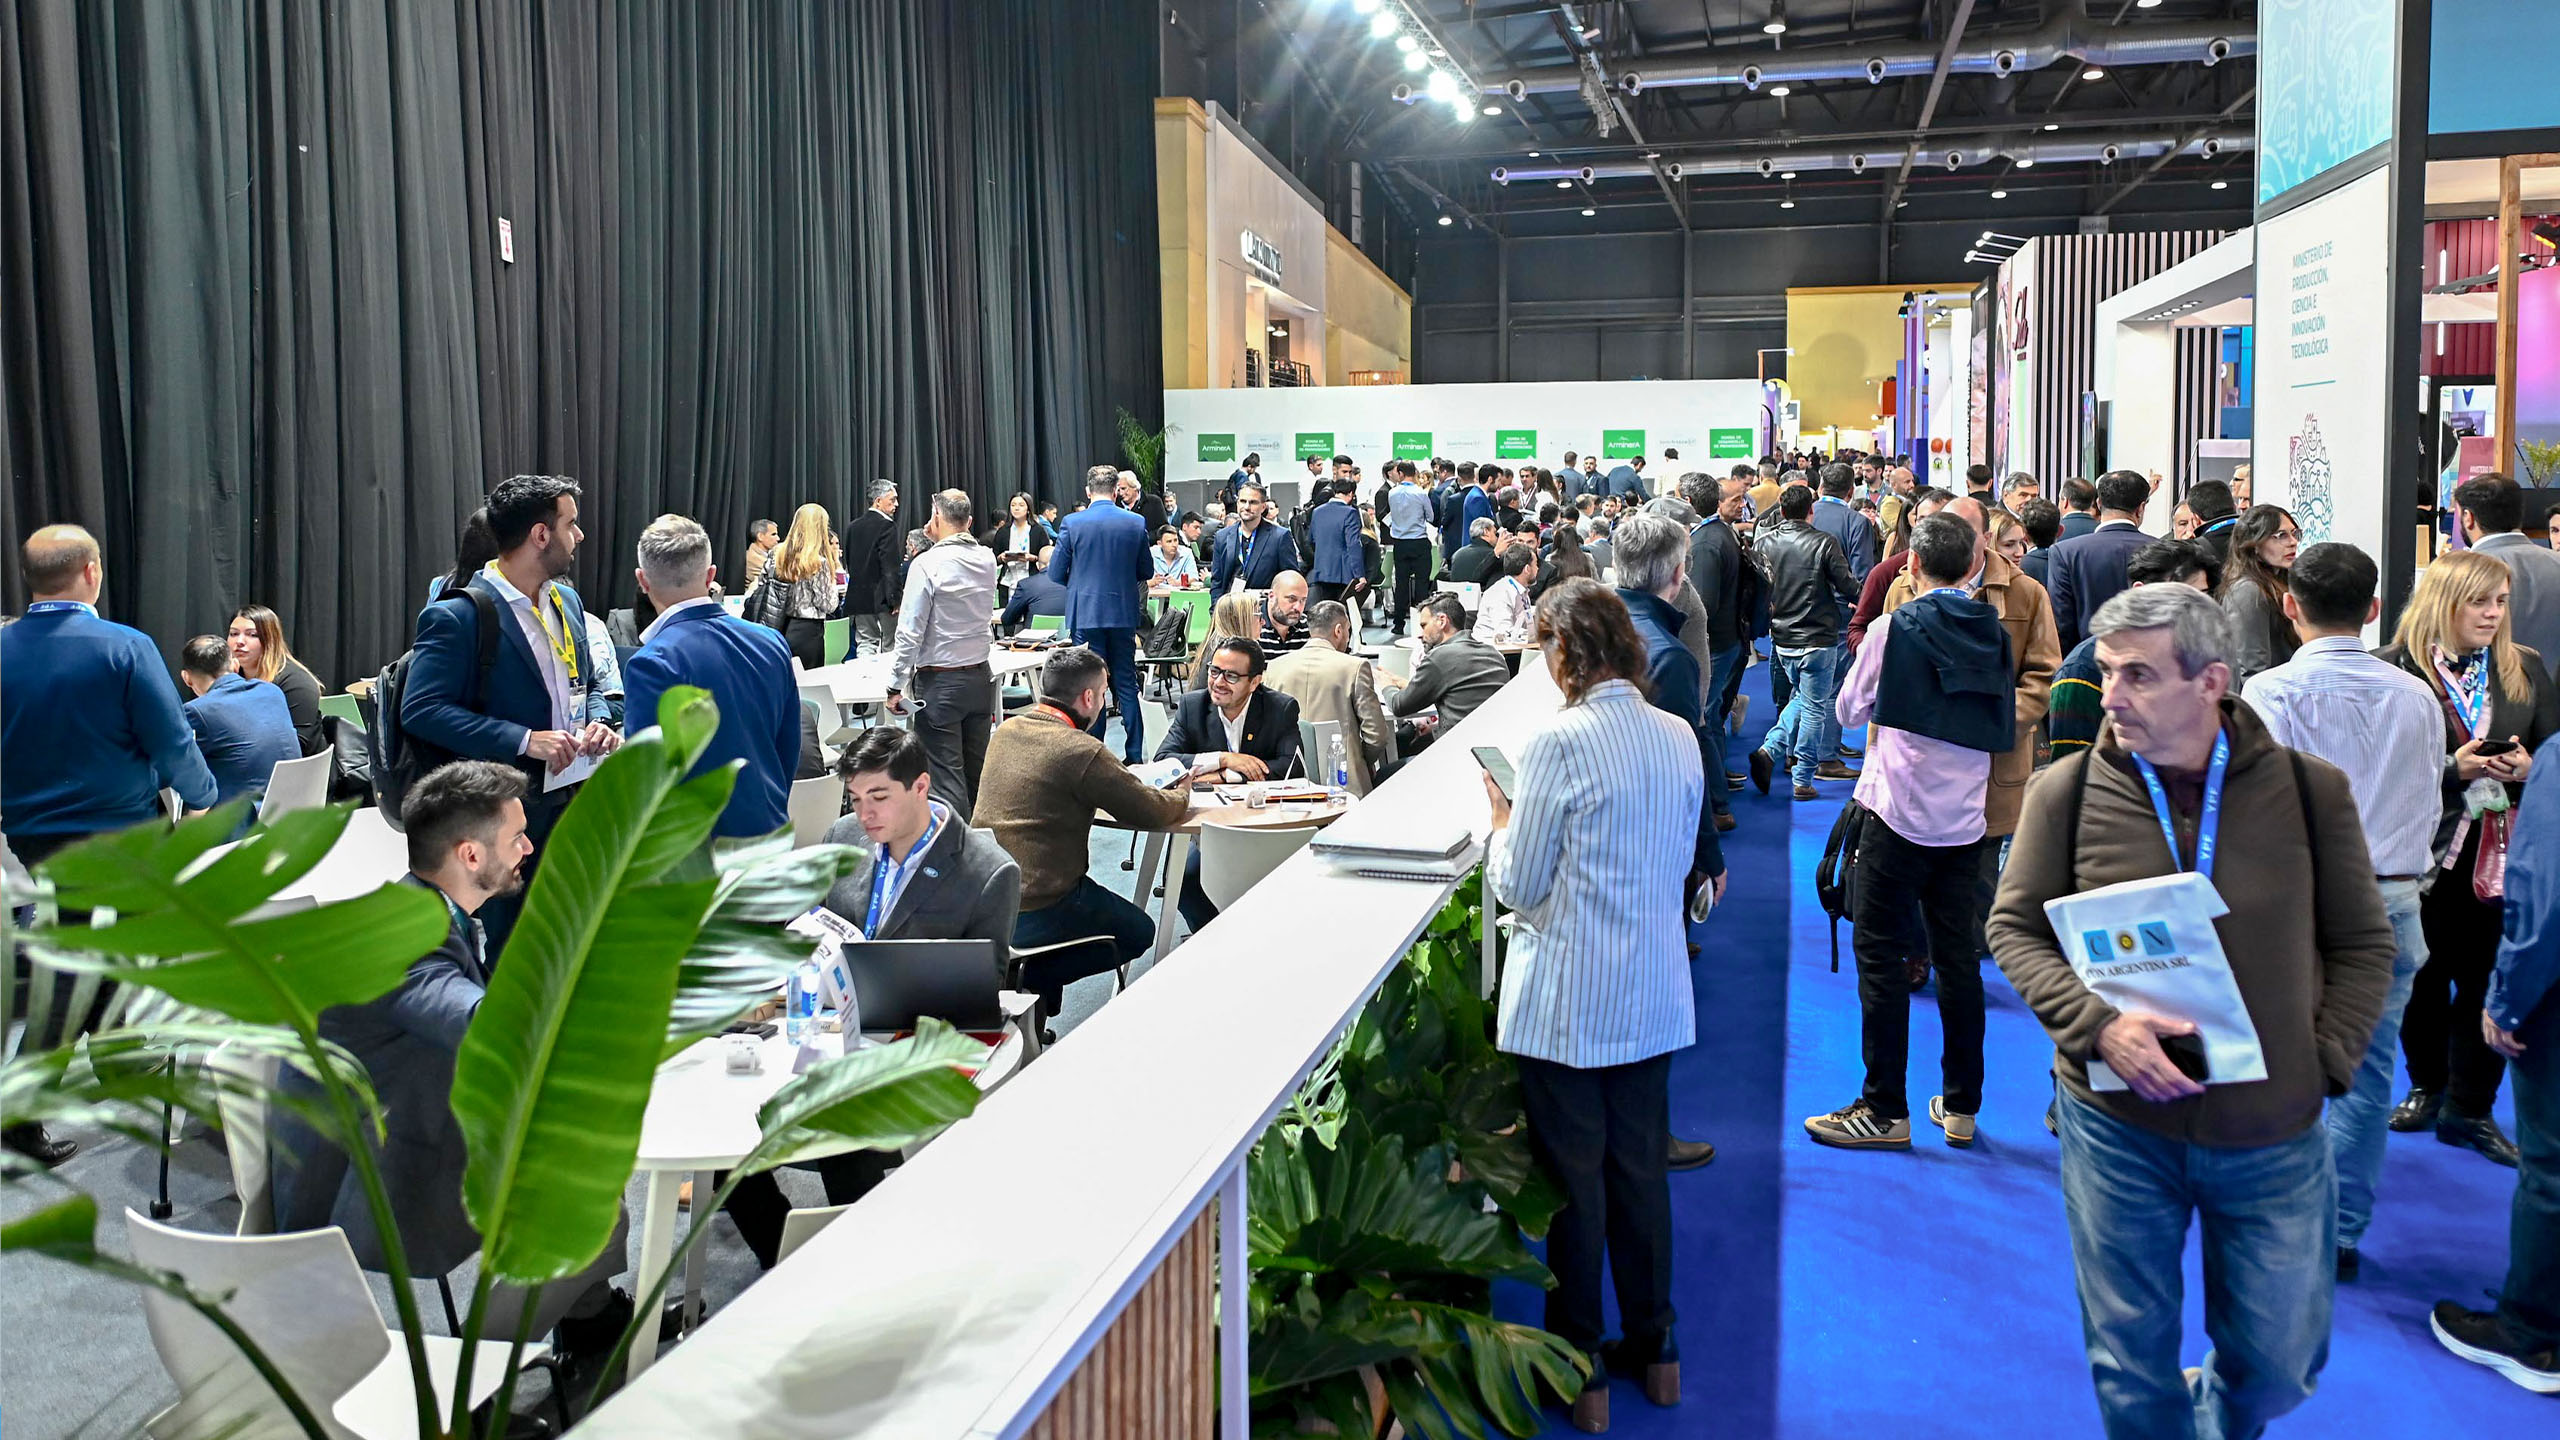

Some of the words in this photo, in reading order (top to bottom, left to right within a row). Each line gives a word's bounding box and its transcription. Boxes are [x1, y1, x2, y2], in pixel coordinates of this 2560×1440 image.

[2293, 245, 2323, 267] MINISTERIO
[2324, 241, 2332, 257] DE
[2292, 265, 2328, 291] PRODUCCIÓN,
[2292, 296, 2312, 314] CIENCIA
[2292, 312, 2325, 336] INNOVACIÓN
[2291, 337, 2328, 360] TECNOLÓGICA
[2213, 742, 2228, 766] YPF
[2205, 785, 2218, 813] YPF
[922, 826, 934, 841] YPF
[2200, 833, 2213, 860] YPF
[878, 861, 888, 879] YPF
[871, 892, 880, 910] YPF
[2107, 960, 2169, 977] ARGENTINA
[2168, 955, 2193, 969] SRL
